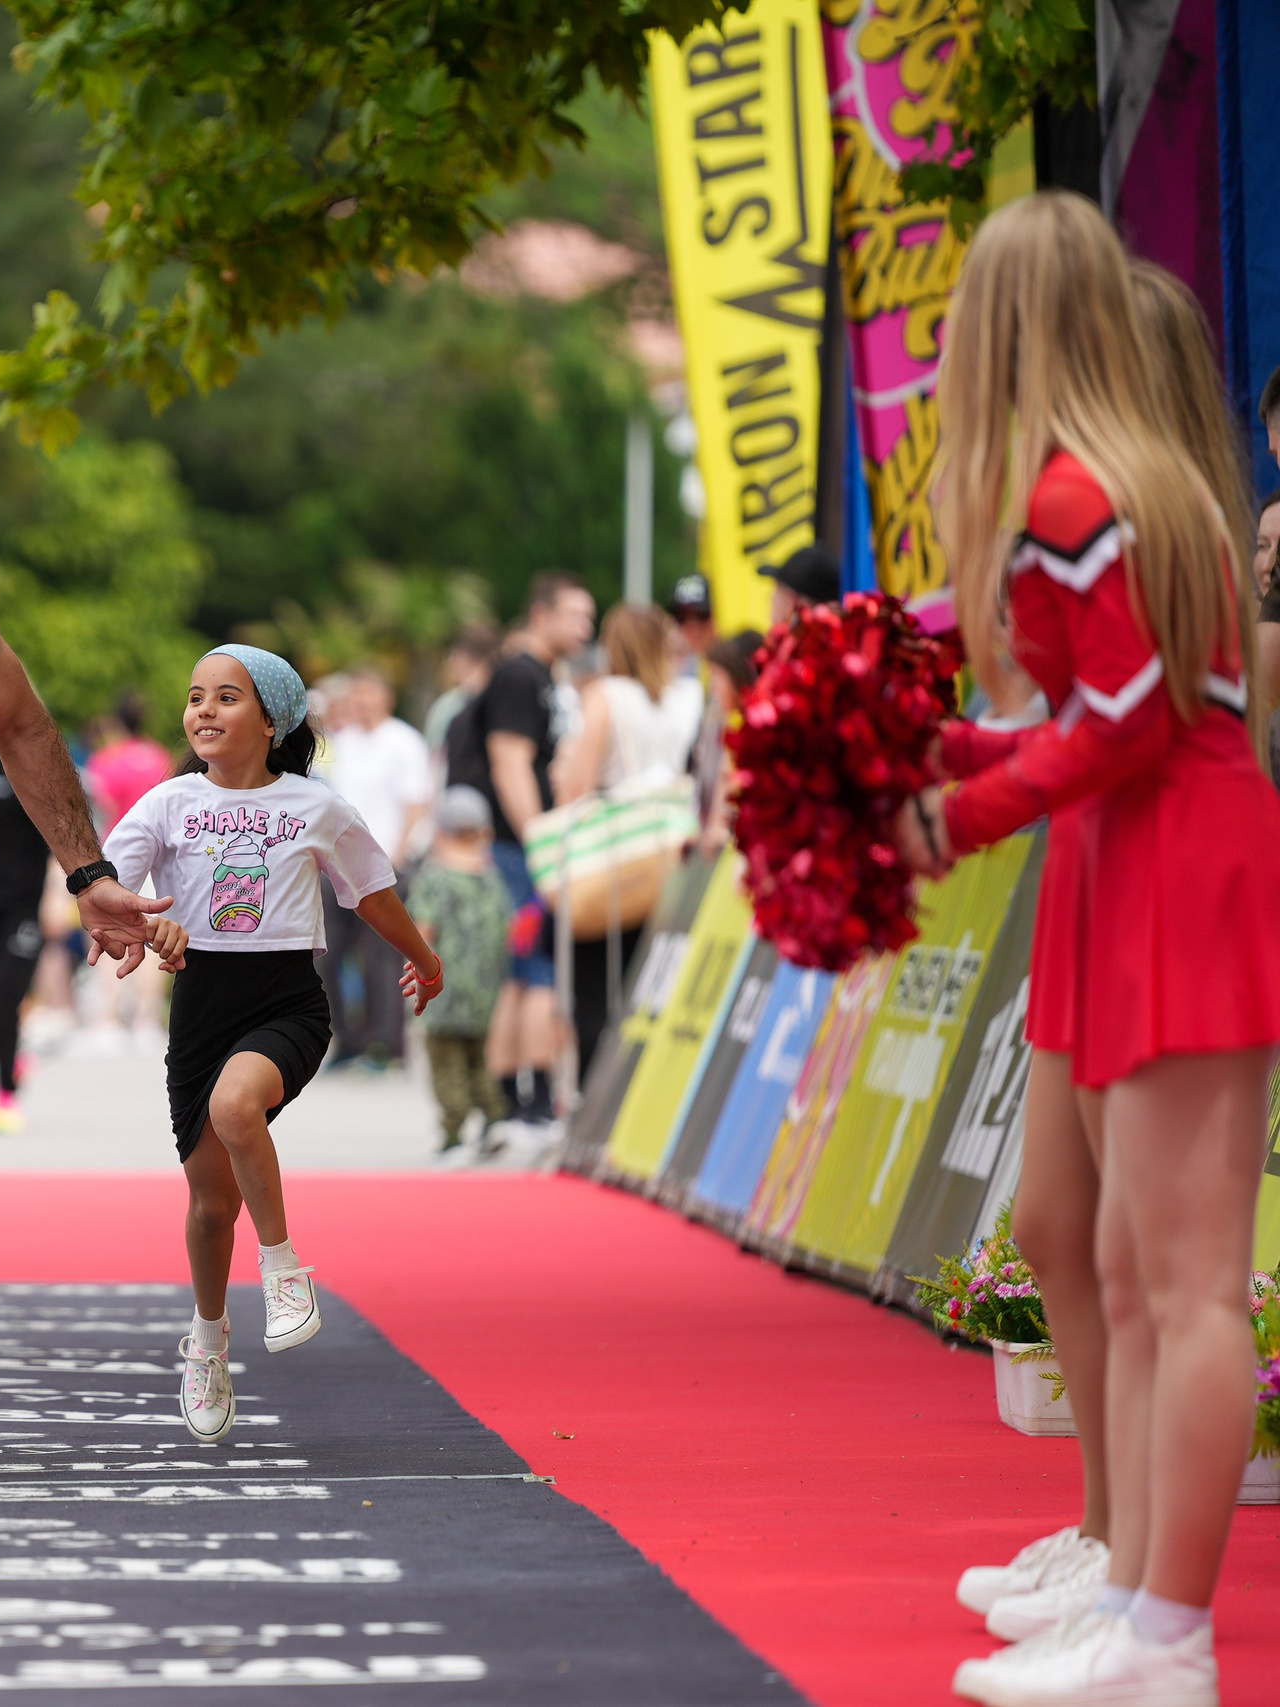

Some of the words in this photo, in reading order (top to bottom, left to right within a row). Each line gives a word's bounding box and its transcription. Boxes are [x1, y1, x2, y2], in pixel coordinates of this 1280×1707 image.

[686, 28, 772, 249] STAR
[723, 347, 819, 557] IRON
[17, 1655, 487, 1683] STAR
